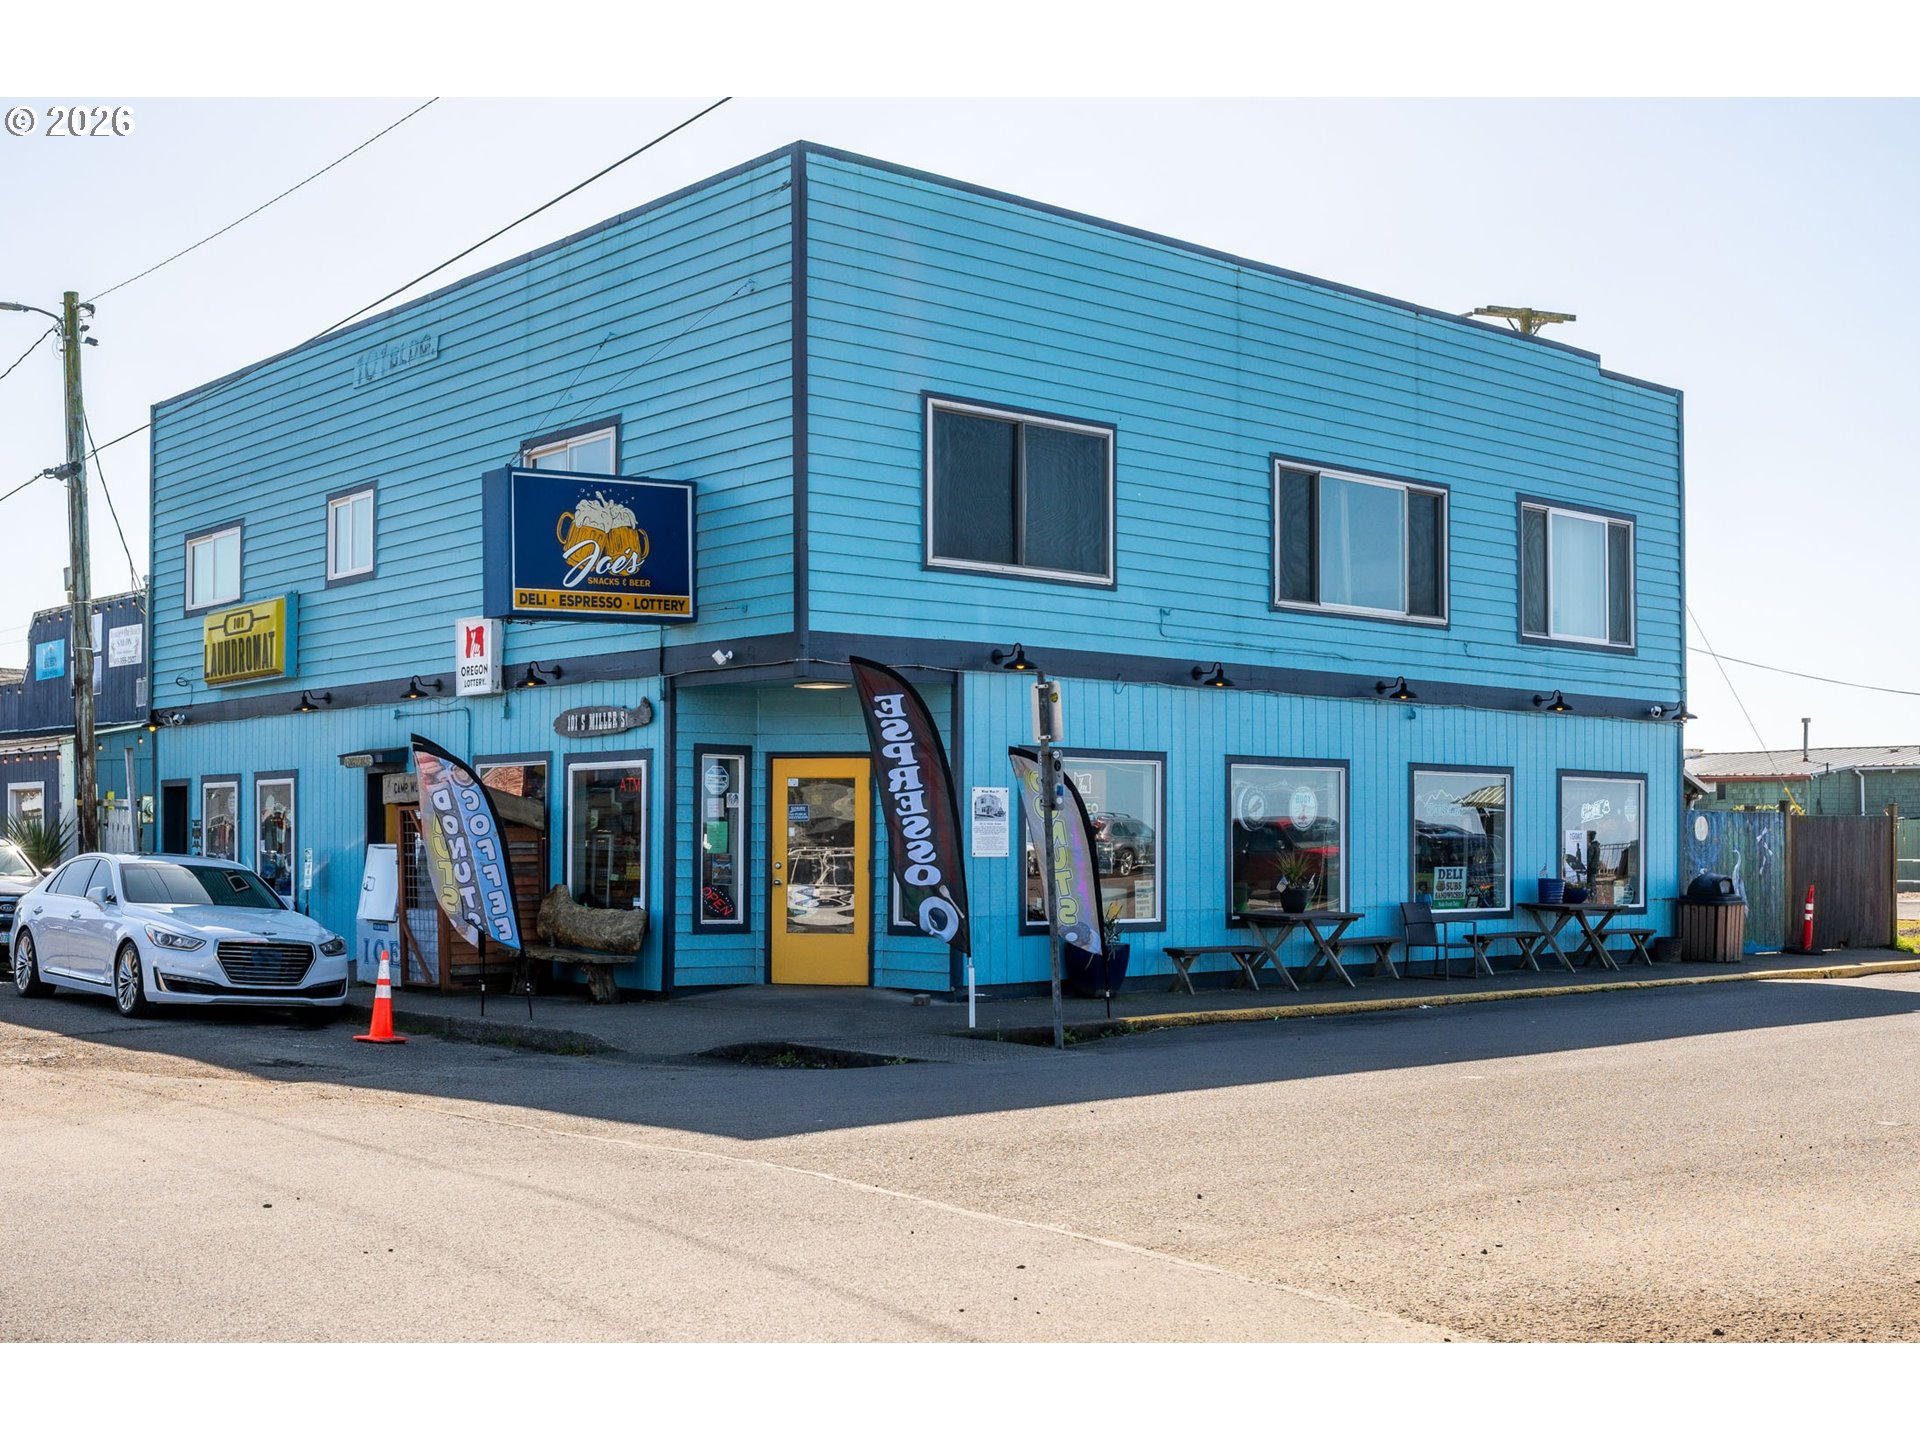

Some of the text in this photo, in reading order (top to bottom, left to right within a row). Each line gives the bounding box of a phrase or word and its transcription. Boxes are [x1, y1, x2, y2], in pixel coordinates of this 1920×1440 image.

[562, 540, 644, 587] Joe's
[588, 577, 619, 586] SNACKS
[629, 579, 650, 587] BEER
[519, 592, 685, 611] DELI ESPRESSO LOTTERY
[234, 616, 244, 630] 101
[205, 632, 275, 678] LAUNDROMAT
[461, 664, 488, 677] OREGON
[567, 714, 578, 732] 101
[589, 711, 618, 731] MILLER
[394, 782, 408, 794] CAMP
[620, 776, 641, 792] ATM
[1438, 868, 1463, 880] DELI
[1446, 882, 1462, 890] SUBS
[703, 887, 733, 916] OPEN
[363, 938, 400, 967] ICE
